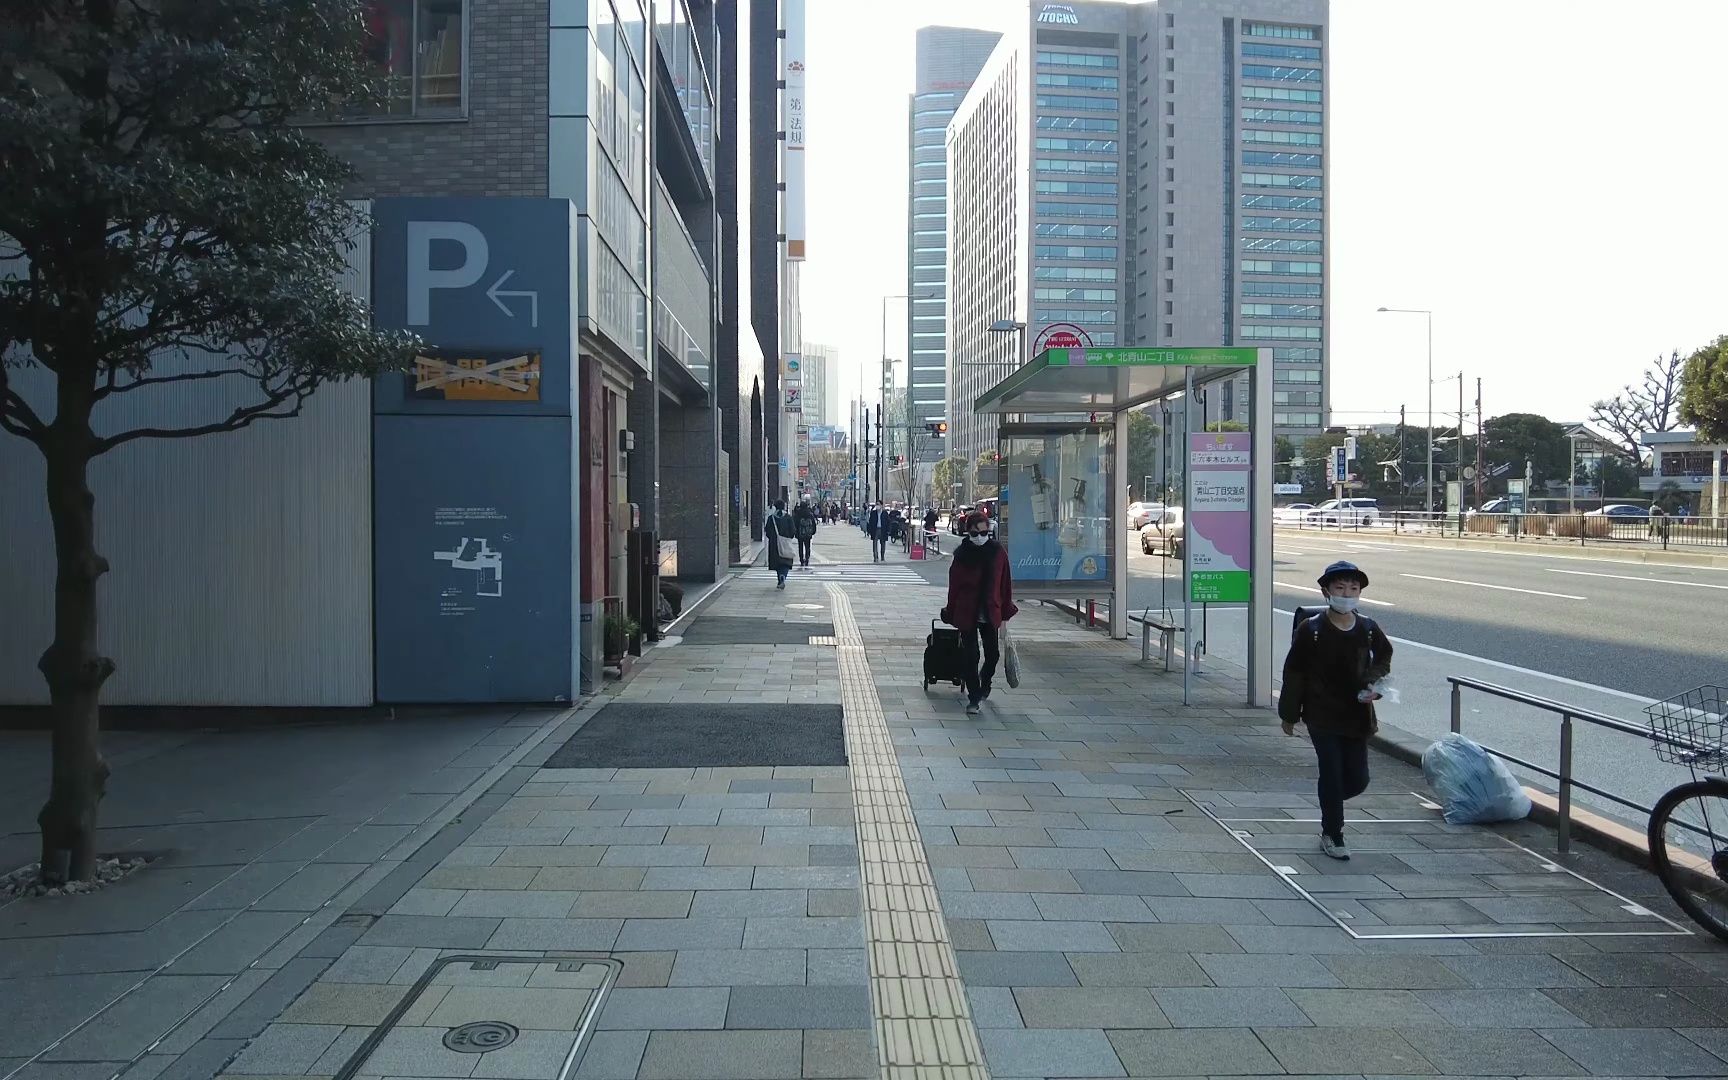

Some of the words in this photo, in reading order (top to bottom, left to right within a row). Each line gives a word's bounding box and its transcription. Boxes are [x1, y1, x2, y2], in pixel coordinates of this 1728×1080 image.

[1037, 12, 1078, 24] ITOCHU
[790, 97, 802, 144] 第一法規
[407, 220, 489, 326] P
[1118, 351, 1174, 362] 北青山二丁目
[1197, 486, 1246, 496] 青山二丁目交差点
[1017, 554, 1041, 568] plus
[1042, 558, 1063, 566] eau
